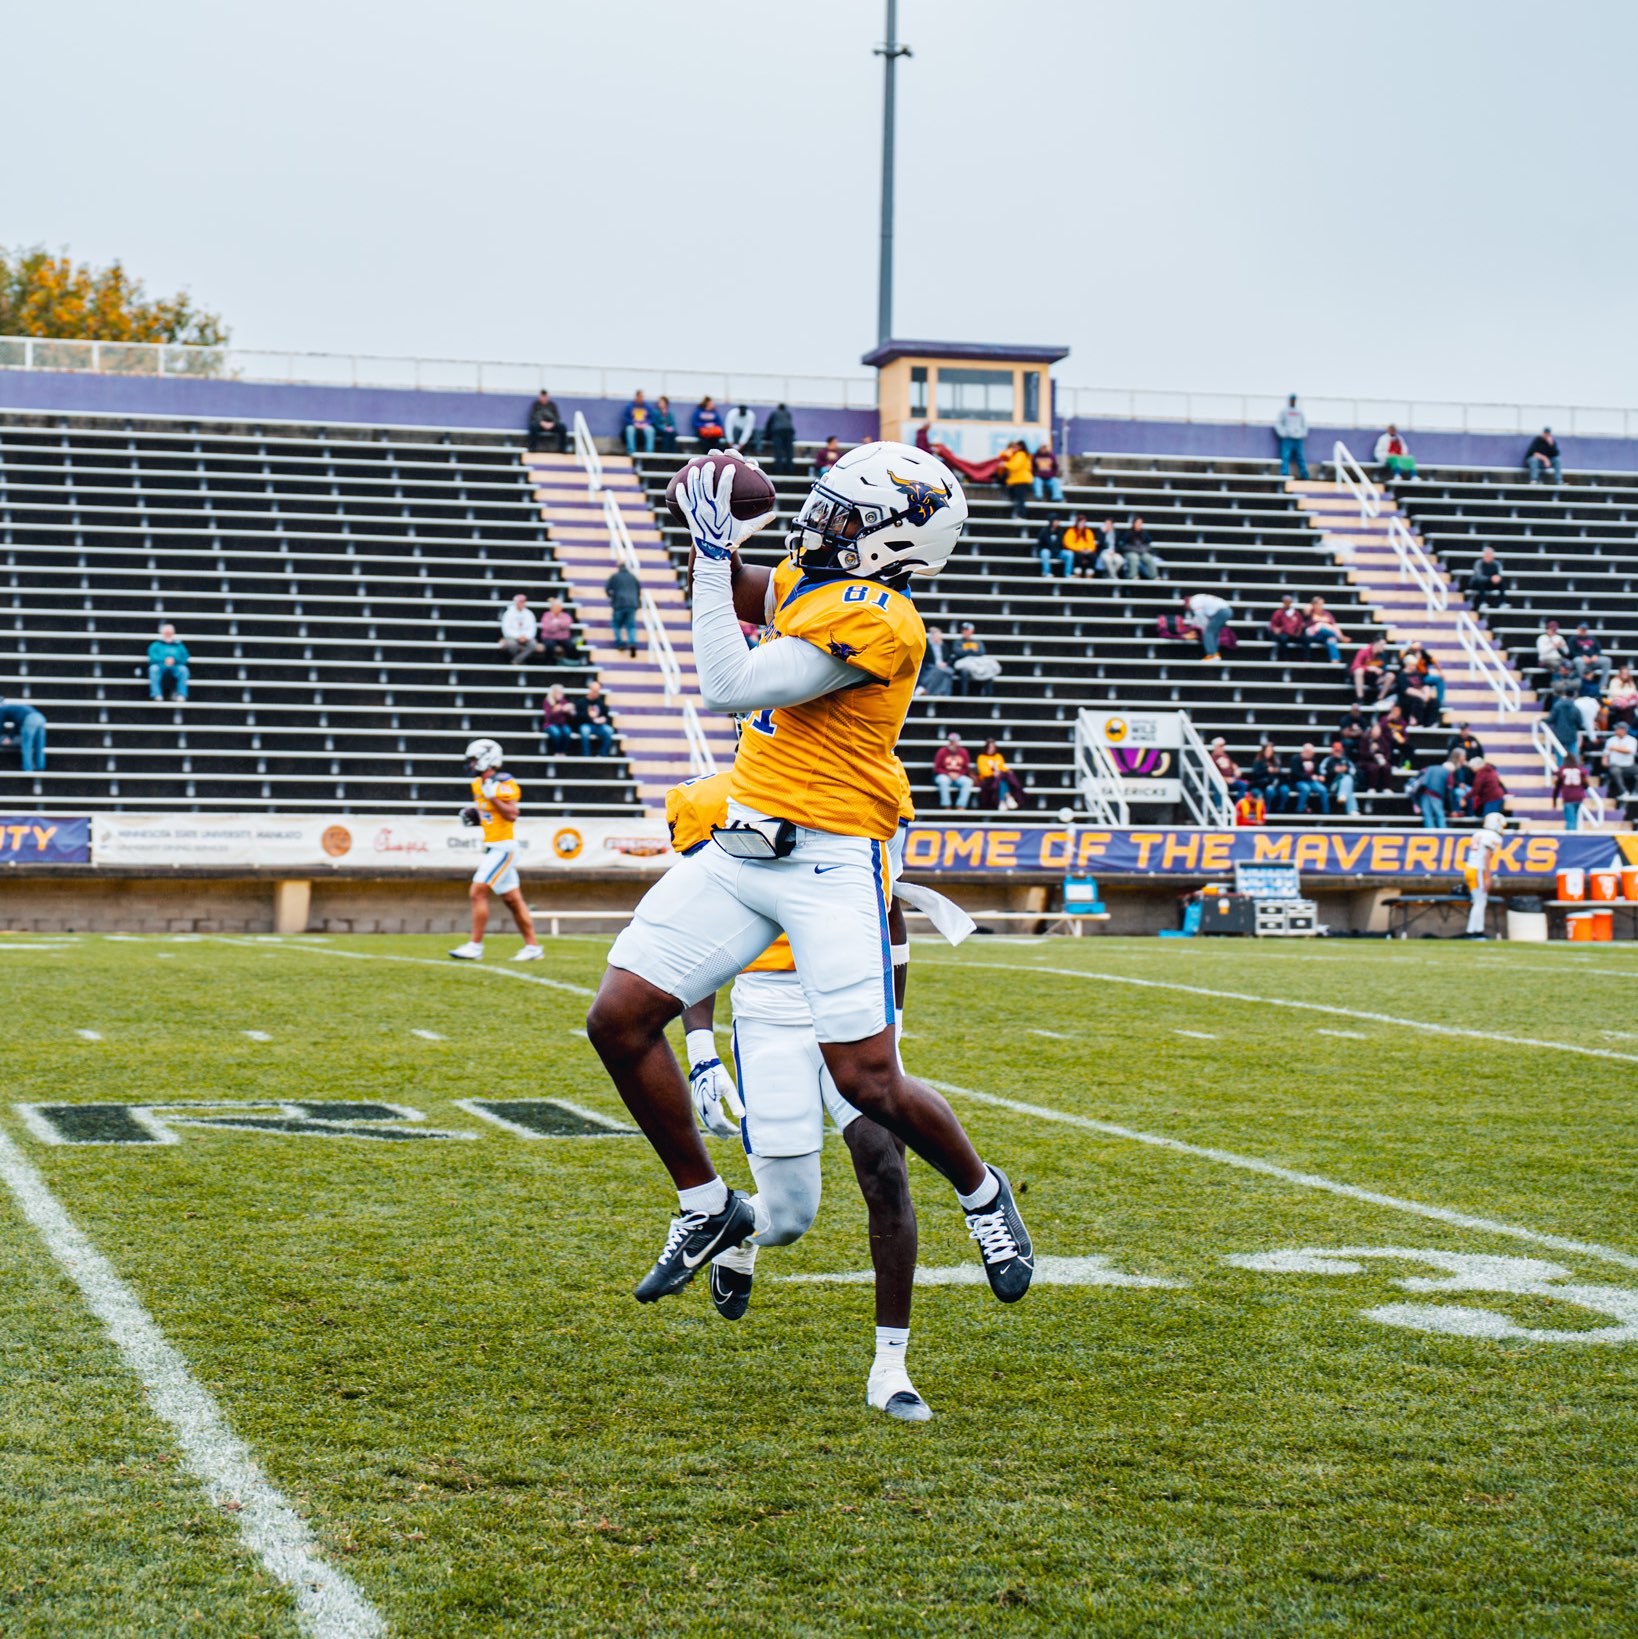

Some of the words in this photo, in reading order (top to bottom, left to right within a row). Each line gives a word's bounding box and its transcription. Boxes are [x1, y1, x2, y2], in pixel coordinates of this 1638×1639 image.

[842, 585, 891, 613] 81
[904, 830, 1021, 867] OME
[1039, 832, 1111, 867] OF
[1129, 833, 1236, 869] THE
